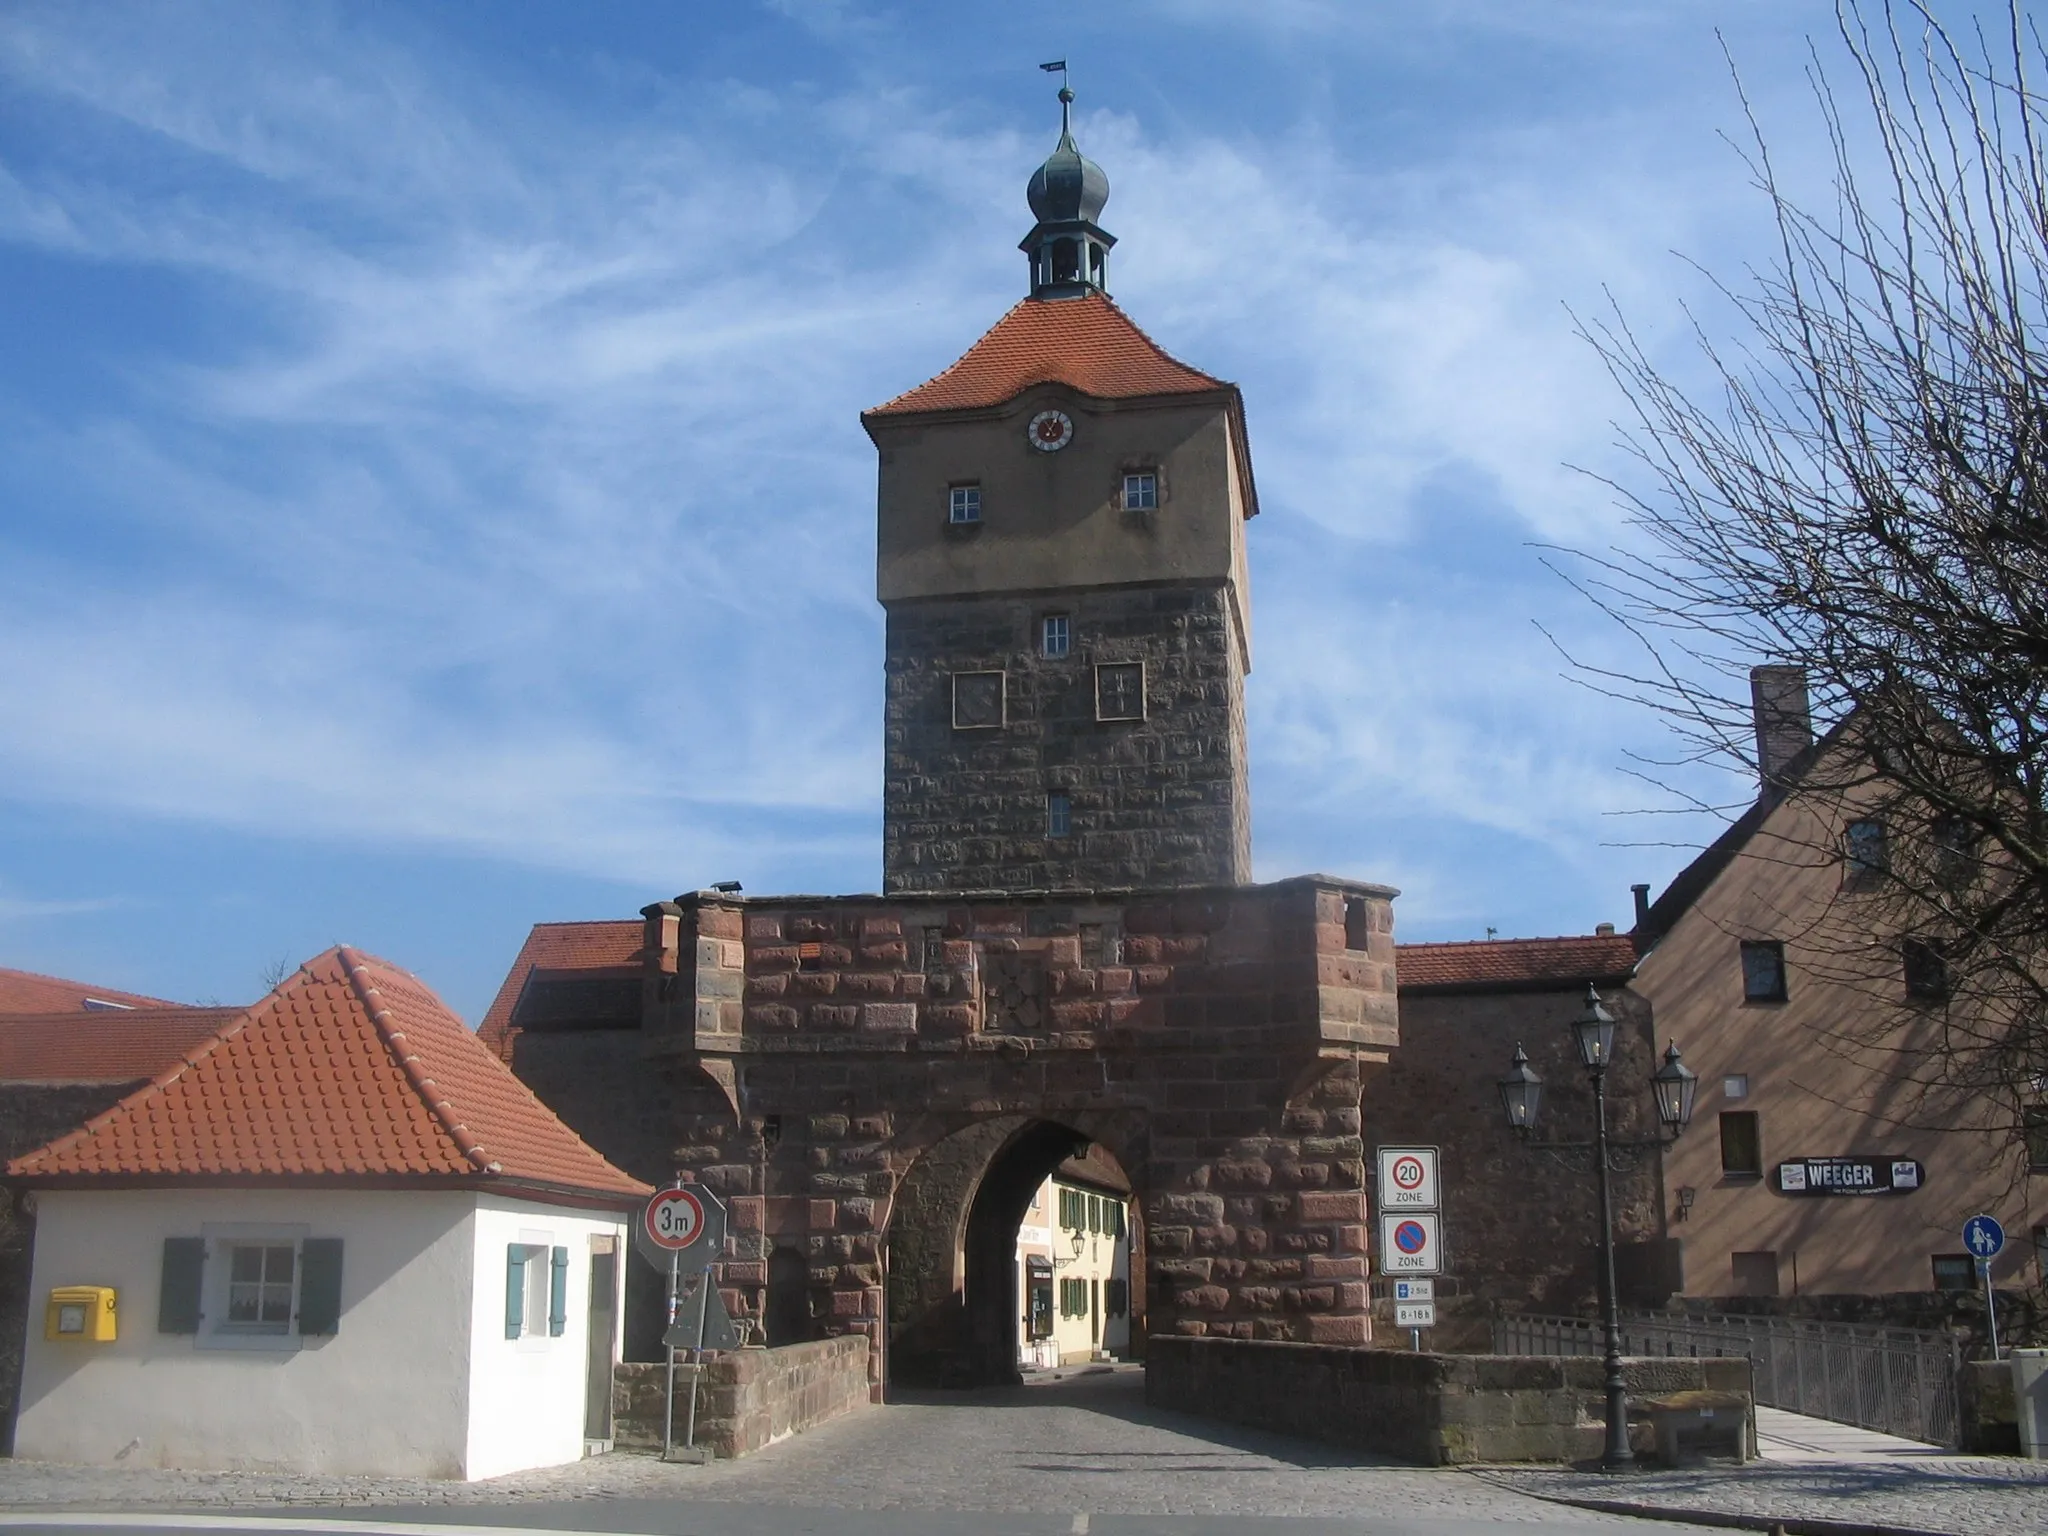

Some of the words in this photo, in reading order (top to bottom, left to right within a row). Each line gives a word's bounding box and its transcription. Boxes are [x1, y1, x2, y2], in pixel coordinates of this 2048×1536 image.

[1399, 1165, 1418, 1181] 20
[1808, 1164, 1874, 1186] WEEGER
[1396, 1192, 1423, 1202] ZONE
[661, 1206, 671, 1231] 3
[675, 1217, 688, 1231] m
[1398, 1256, 1425, 1267] ZONE
